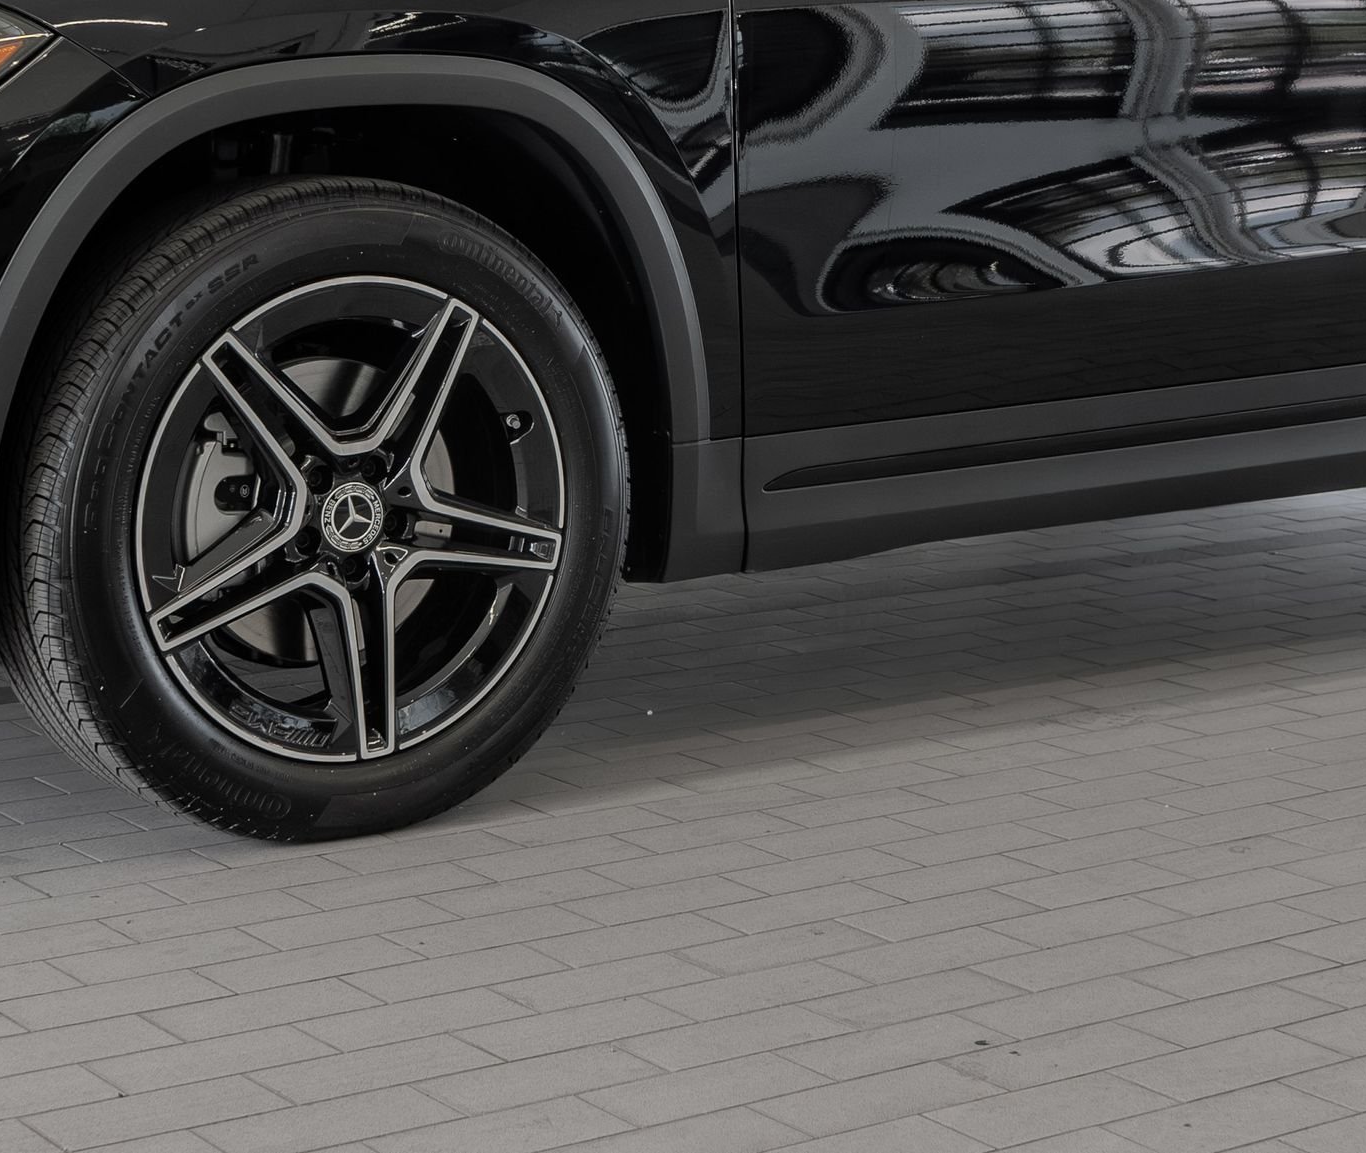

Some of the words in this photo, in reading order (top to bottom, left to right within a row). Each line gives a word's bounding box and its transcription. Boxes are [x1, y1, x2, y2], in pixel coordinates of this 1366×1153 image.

[207, 252, 261, 295] SSR
[438, 231, 554, 315] Continental
[324, 499, 336, 524] BENZ
[362, 499, 382, 545] MERCEDES
